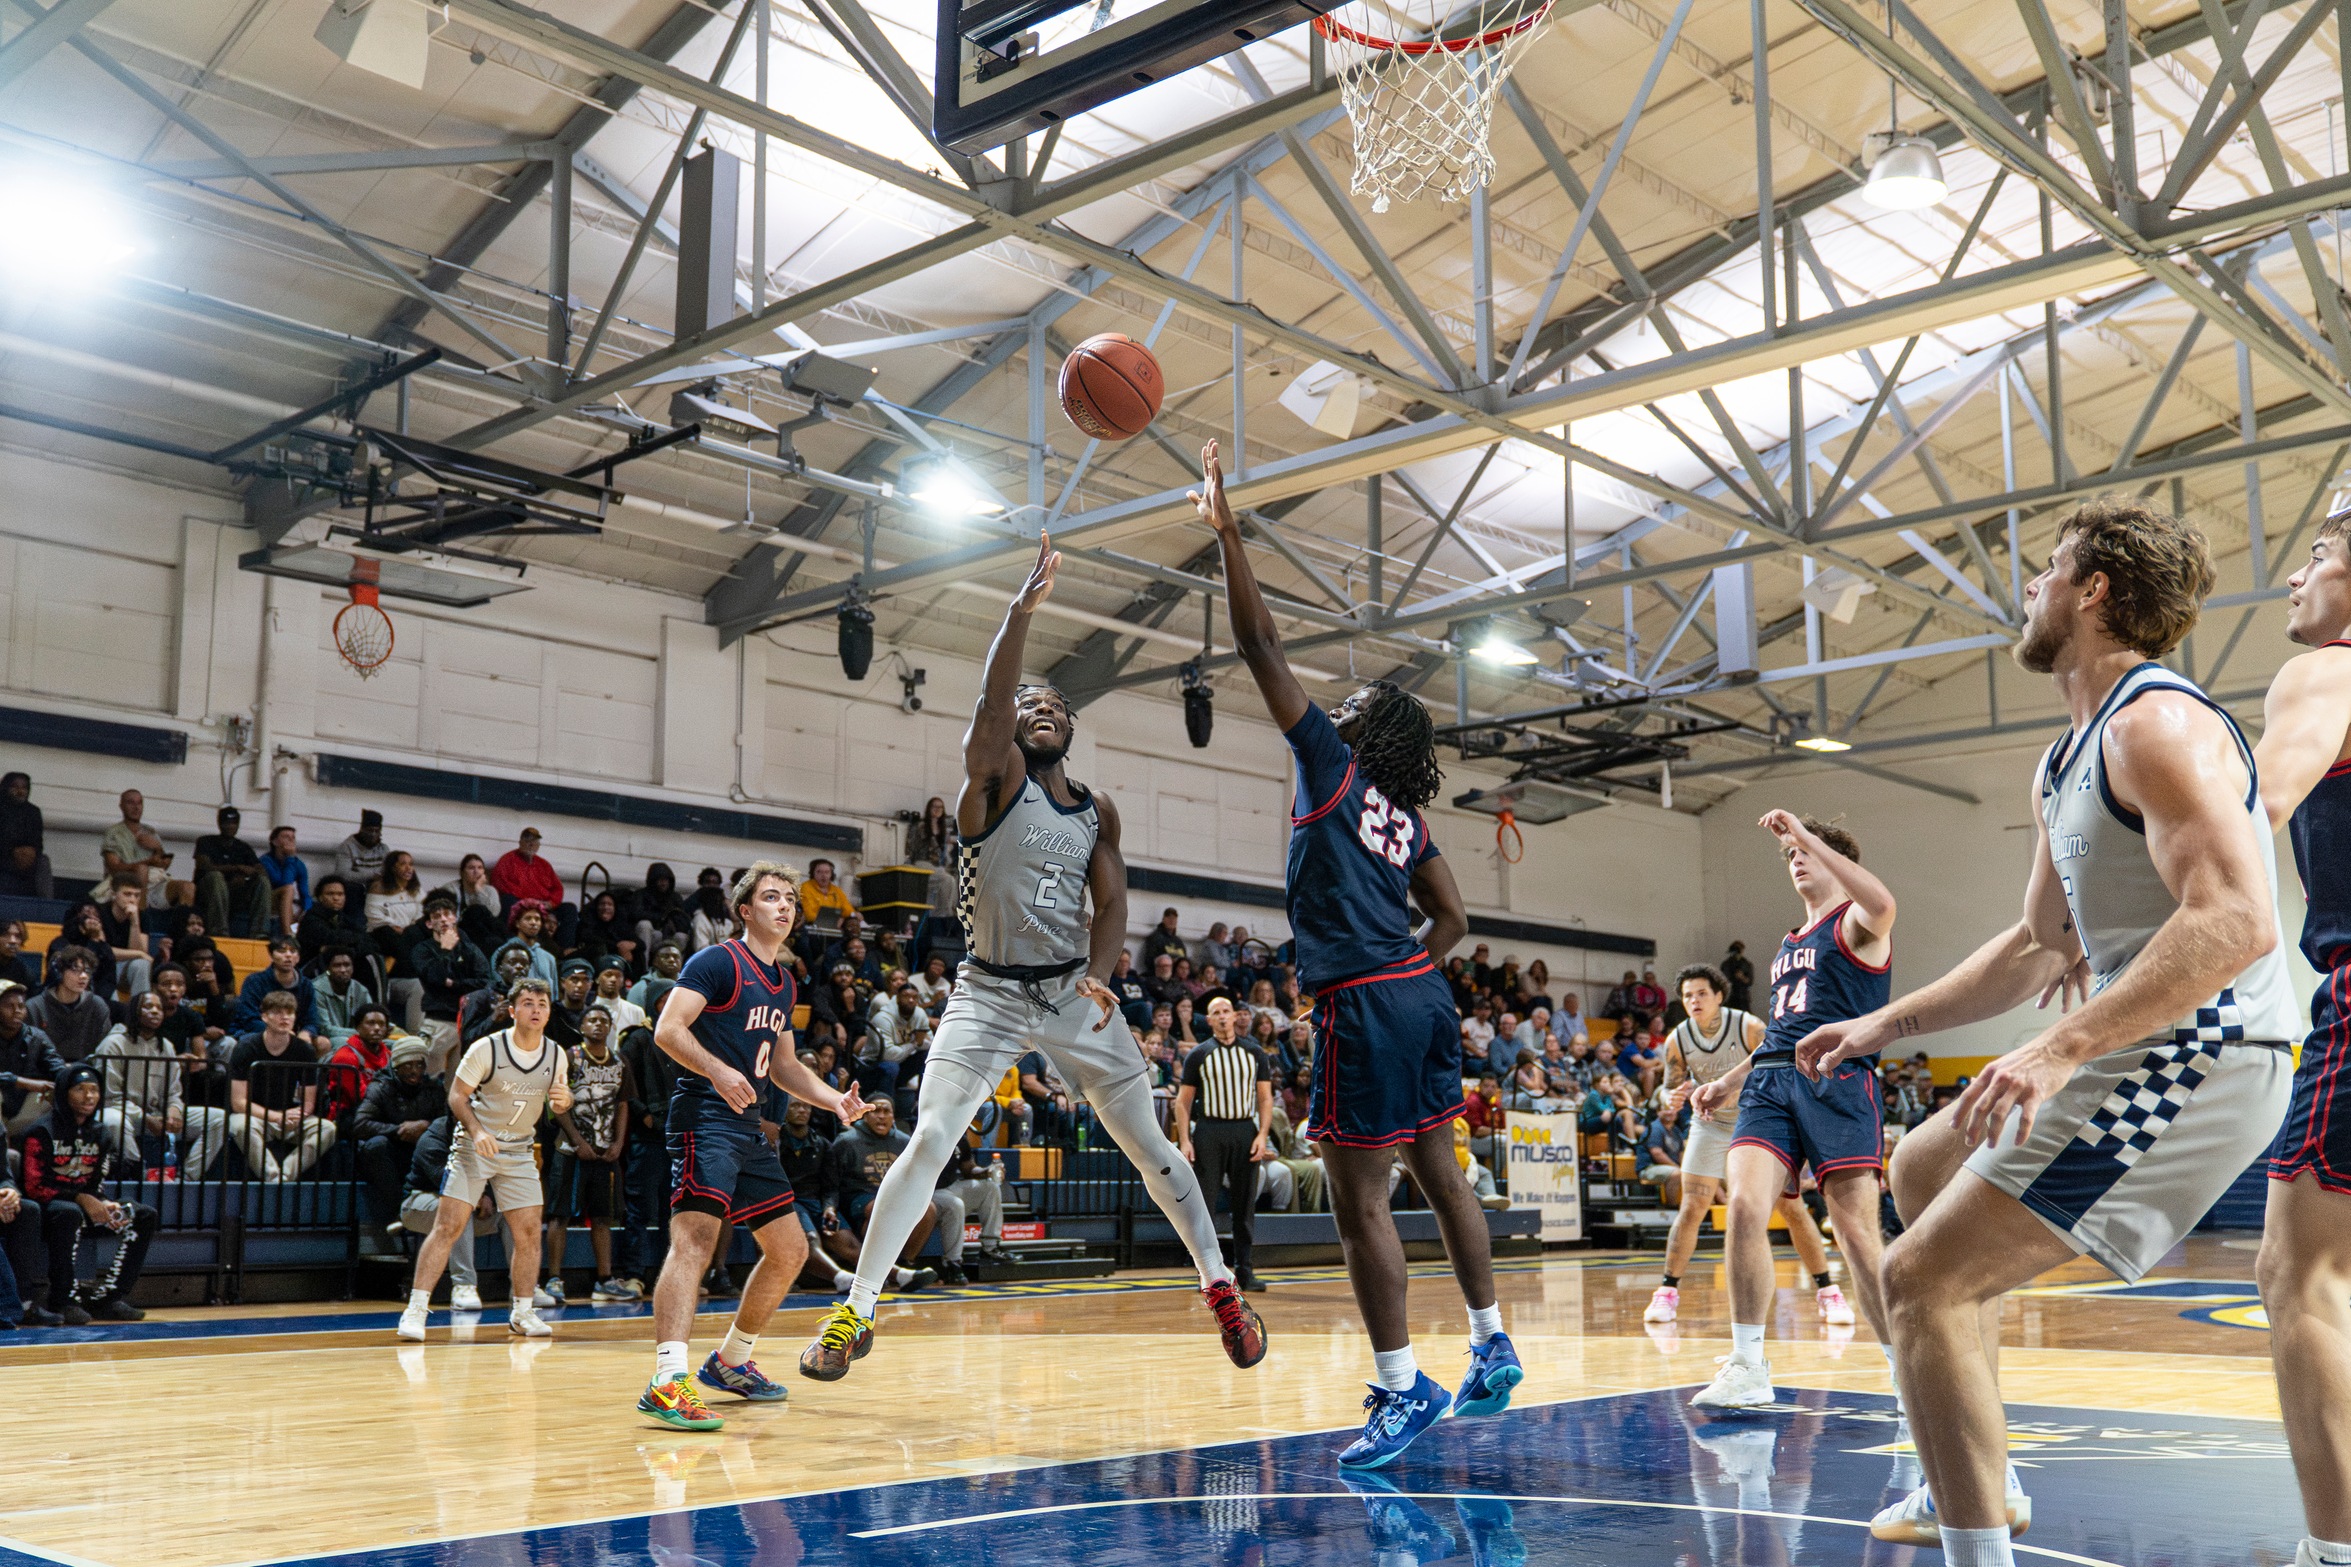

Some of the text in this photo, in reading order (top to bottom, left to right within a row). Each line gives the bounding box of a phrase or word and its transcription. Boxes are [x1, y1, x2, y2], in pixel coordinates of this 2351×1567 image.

[1358, 785, 1415, 870] 23
[1032, 860, 1066, 910] 2
[1769, 947, 1817, 987] HLGU
[1773, 976, 1808, 1020] 14
[754, 1039, 771, 1078] 0
[507, 1099, 528, 1127] 7
